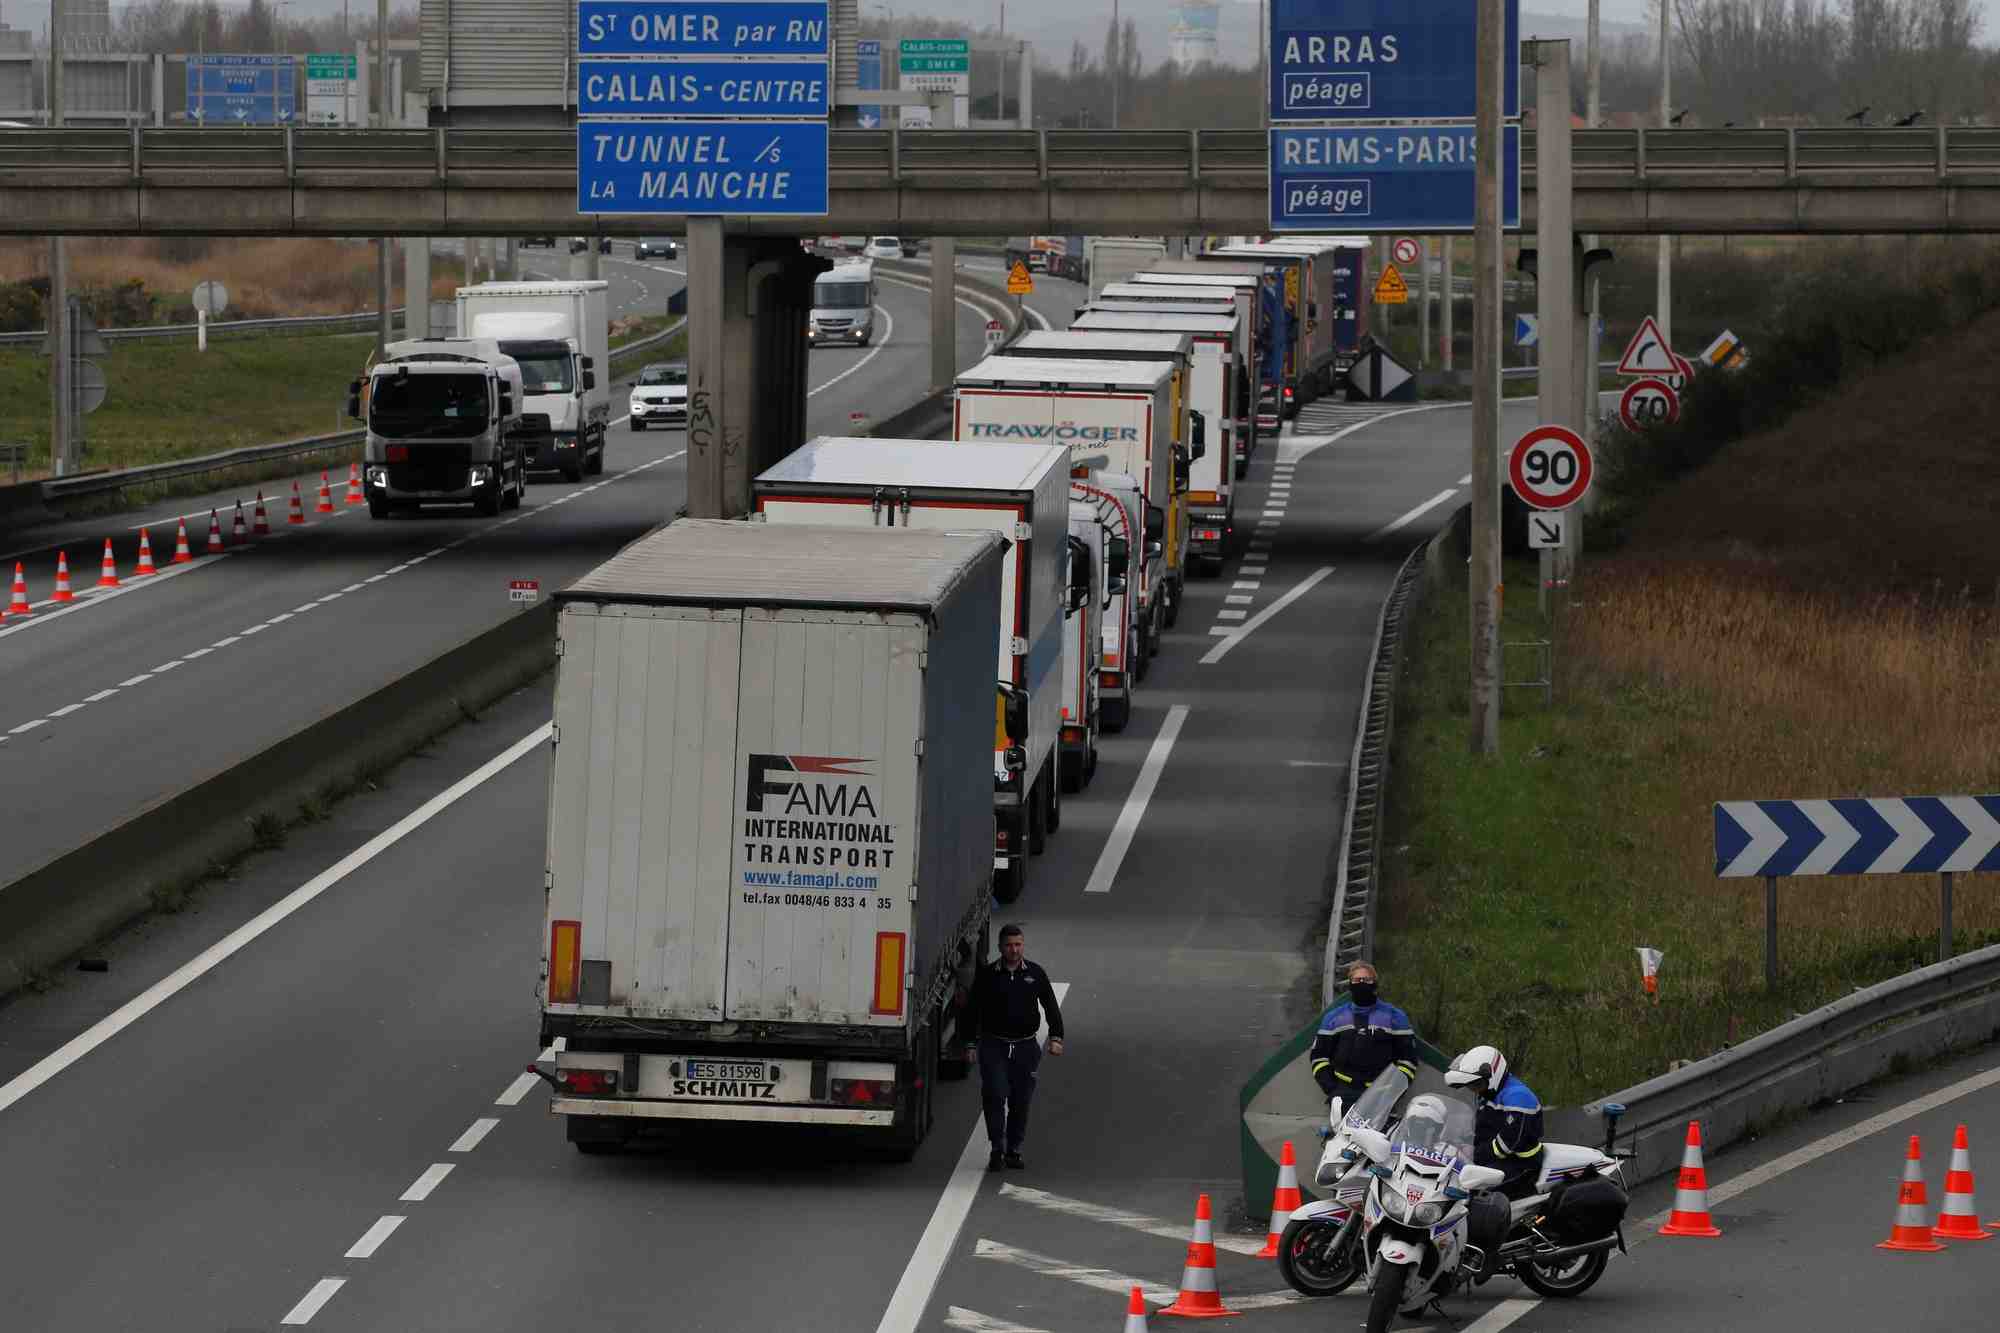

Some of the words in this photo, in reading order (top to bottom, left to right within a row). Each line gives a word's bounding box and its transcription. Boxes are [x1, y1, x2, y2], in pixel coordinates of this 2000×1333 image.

[631, 14, 719, 42] OMER
[735, 25, 776, 47] par
[786, 20, 823, 42] RN
[1284, 35, 1398, 63] ARRAS
[1289, 79, 1363, 104] péage
[594, 136, 730, 163] TUNNEL
[590, 181, 616, 198] LA
[639, 172, 790, 199] MANCHE
[1289, 185, 1363, 212] péage
[1632, 396, 1667, 421] 70
[967, 421, 1139, 441] TRAWÖGER
[1526, 449, 1577, 485] 90
[746, 754, 877, 818] FAMA
[745, 819, 895, 843] INTERNATIONAL
[745, 844, 894, 868] TRANSPORT
[744, 870, 877, 889] www.famapl.com
[744, 892, 780, 905] tel.fax
[785, 894, 829, 907] 0048/46
[834, 895, 854, 908] 833
[877, 898, 891, 909] 35
[720, 1065, 761, 1079] 81598
[673, 1080, 776, 1098] SCHMITZ
[1407, 1145, 1448, 1162] POLICE
